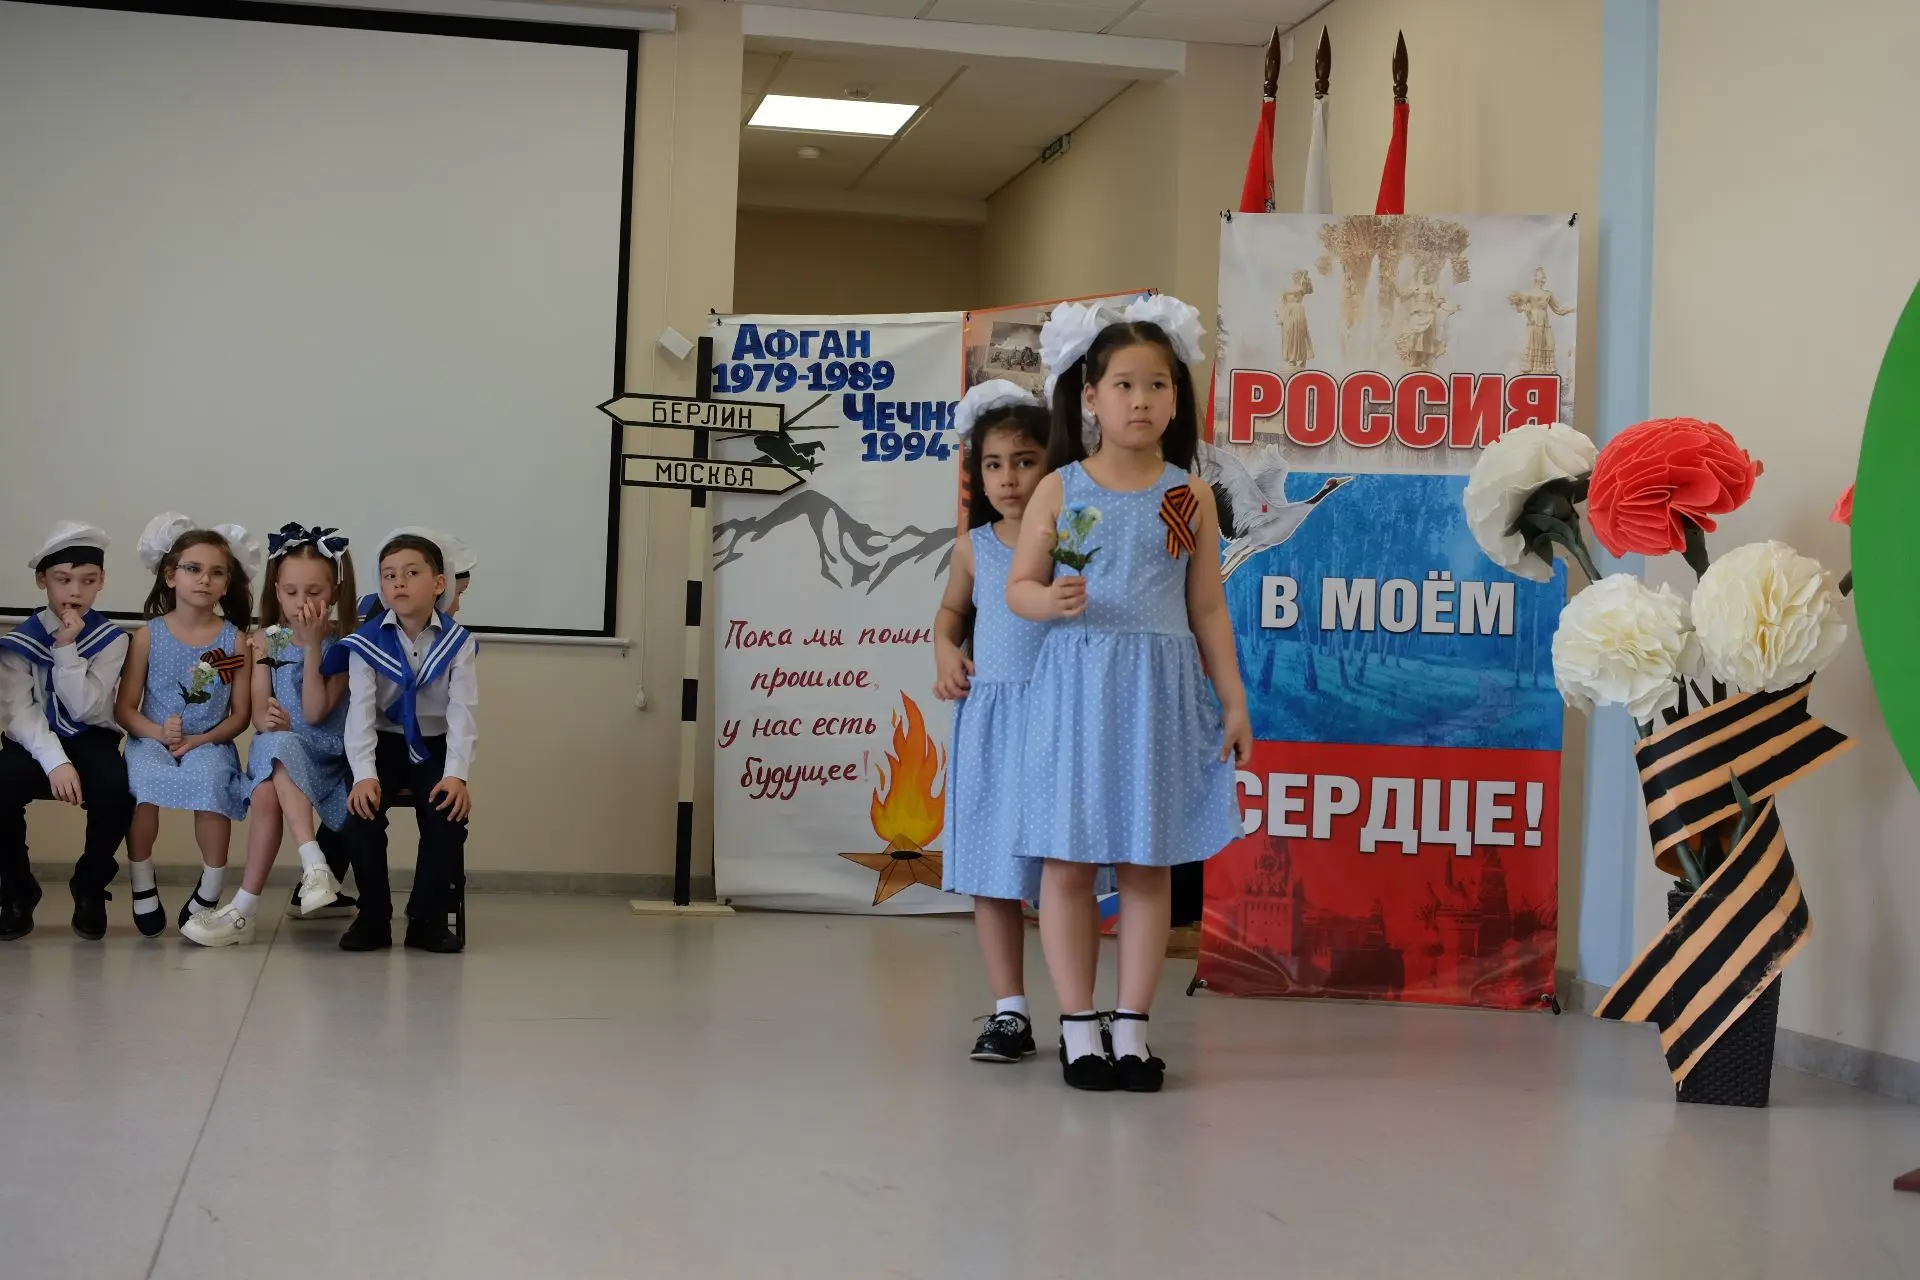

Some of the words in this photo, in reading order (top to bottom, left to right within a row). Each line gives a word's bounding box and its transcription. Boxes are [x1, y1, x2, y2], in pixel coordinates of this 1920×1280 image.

[712, 361, 895, 393] 1979-1989
[652, 401, 753, 429] БЕРЛИН
[1228, 369, 1561, 449] РОССИЯ
[656, 462, 754, 487] МОСКВА
[1260, 575, 1300, 629] В
[1320, 570, 1515, 635] МОЁМ
[725, 620, 793, 650] Пока
[803, 628, 844, 647] мы
[718, 719, 741, 748] у
[752, 718, 802, 738] нас
[811, 717, 877, 736] есть
[740, 750, 870, 800] будущее!
[1235, 770, 1544, 856] СЕРДЦЕ!
